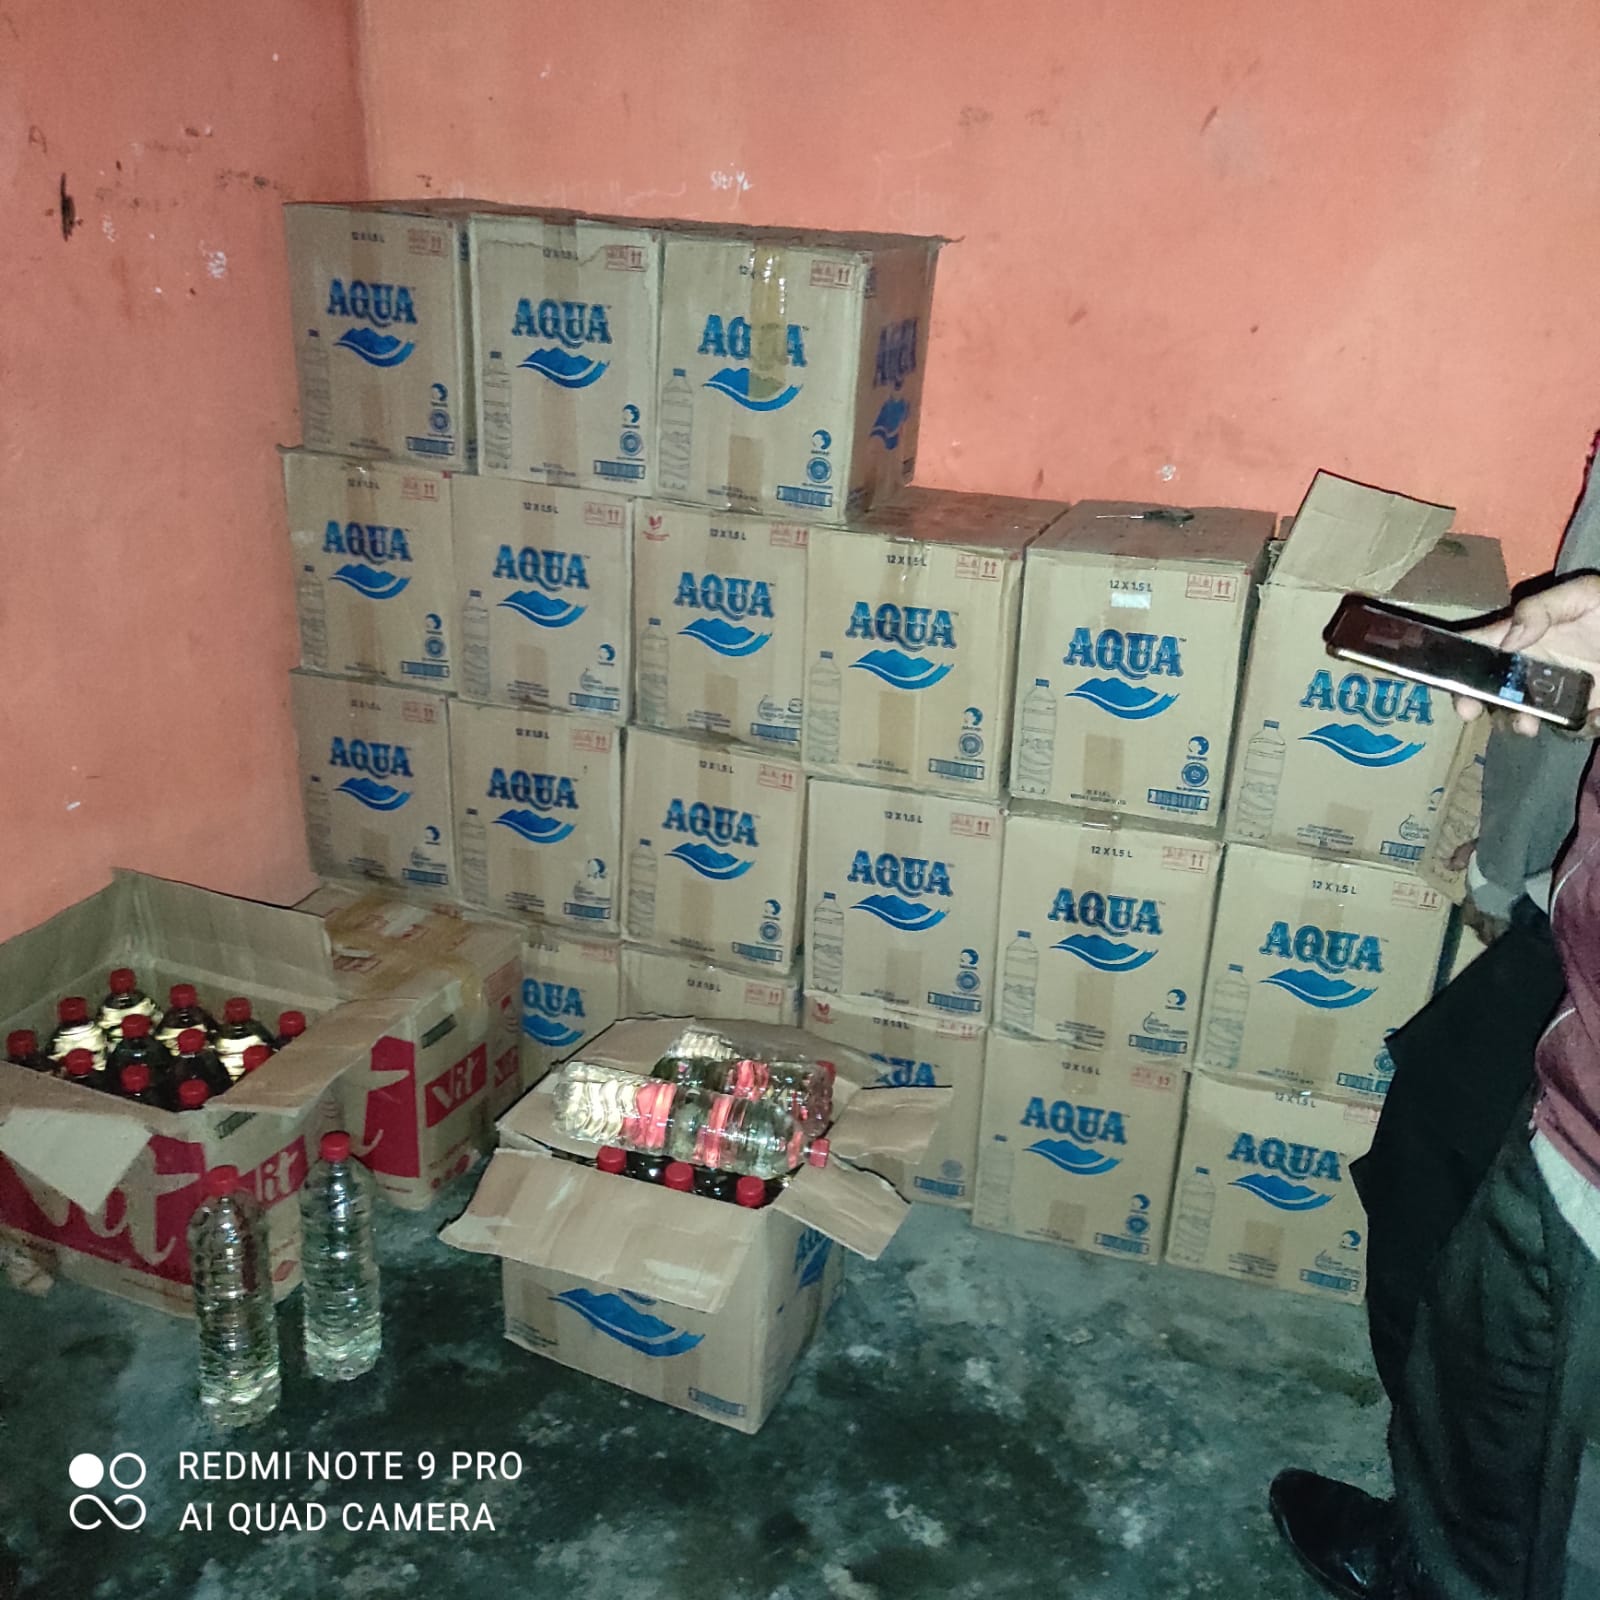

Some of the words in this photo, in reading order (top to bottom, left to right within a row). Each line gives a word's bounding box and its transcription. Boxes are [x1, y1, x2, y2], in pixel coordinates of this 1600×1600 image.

[327, 279, 418, 327] AQUA
[512, 298, 612, 349] AQUA
[697, 314, 807, 370] AQA
[323, 520, 412, 565] AQUA
[493, 544, 590, 591] AQUA
[1110, 580, 1119, 588] 12
[674, 572, 774, 621] AQUA
[845, 601, 956, 652] AQUA
[1063, 627, 1184, 680] AQUA
[1299, 669, 1434, 727] AQUA
[330, 736, 413, 780] AQUA
[488, 767, 579, 811] AQUA
[662, 798, 759, 847] AQUA
[847, 850, 954, 898] AQUA
[1092, 846, 1100, 854] 12
[1312, 880, 1322, 889] 12
[1048, 887, 1163, 937] AQUA
[1259, 921, 1385, 974] AQUA
[522, 978, 586, 1018] QUA
[1020, 1096, 1127, 1144] AQUA
[1227, 1132, 1341, 1181] AQUA
